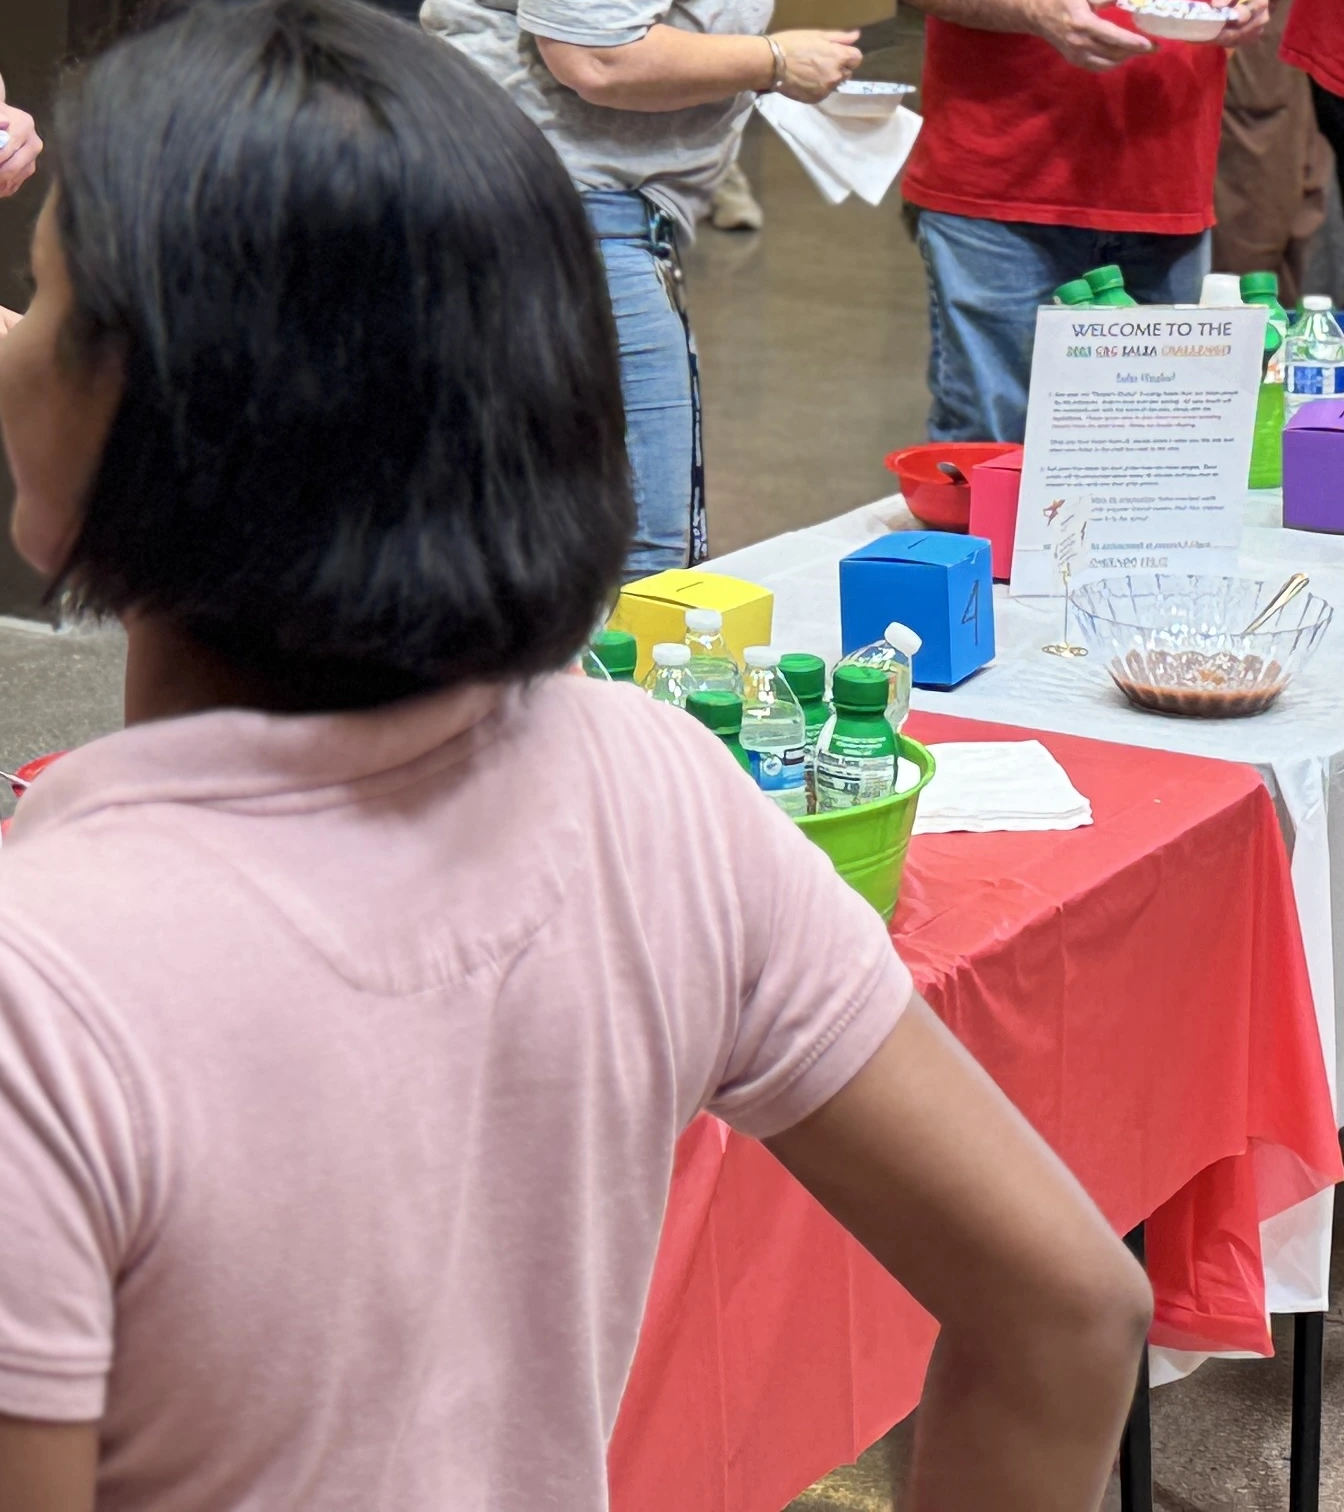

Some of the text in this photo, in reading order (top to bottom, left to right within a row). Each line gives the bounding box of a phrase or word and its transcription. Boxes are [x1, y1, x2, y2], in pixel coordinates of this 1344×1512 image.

[1072, 321, 1233, 338] WELCOME TO THE
[961, 578, 980, 647] 4
